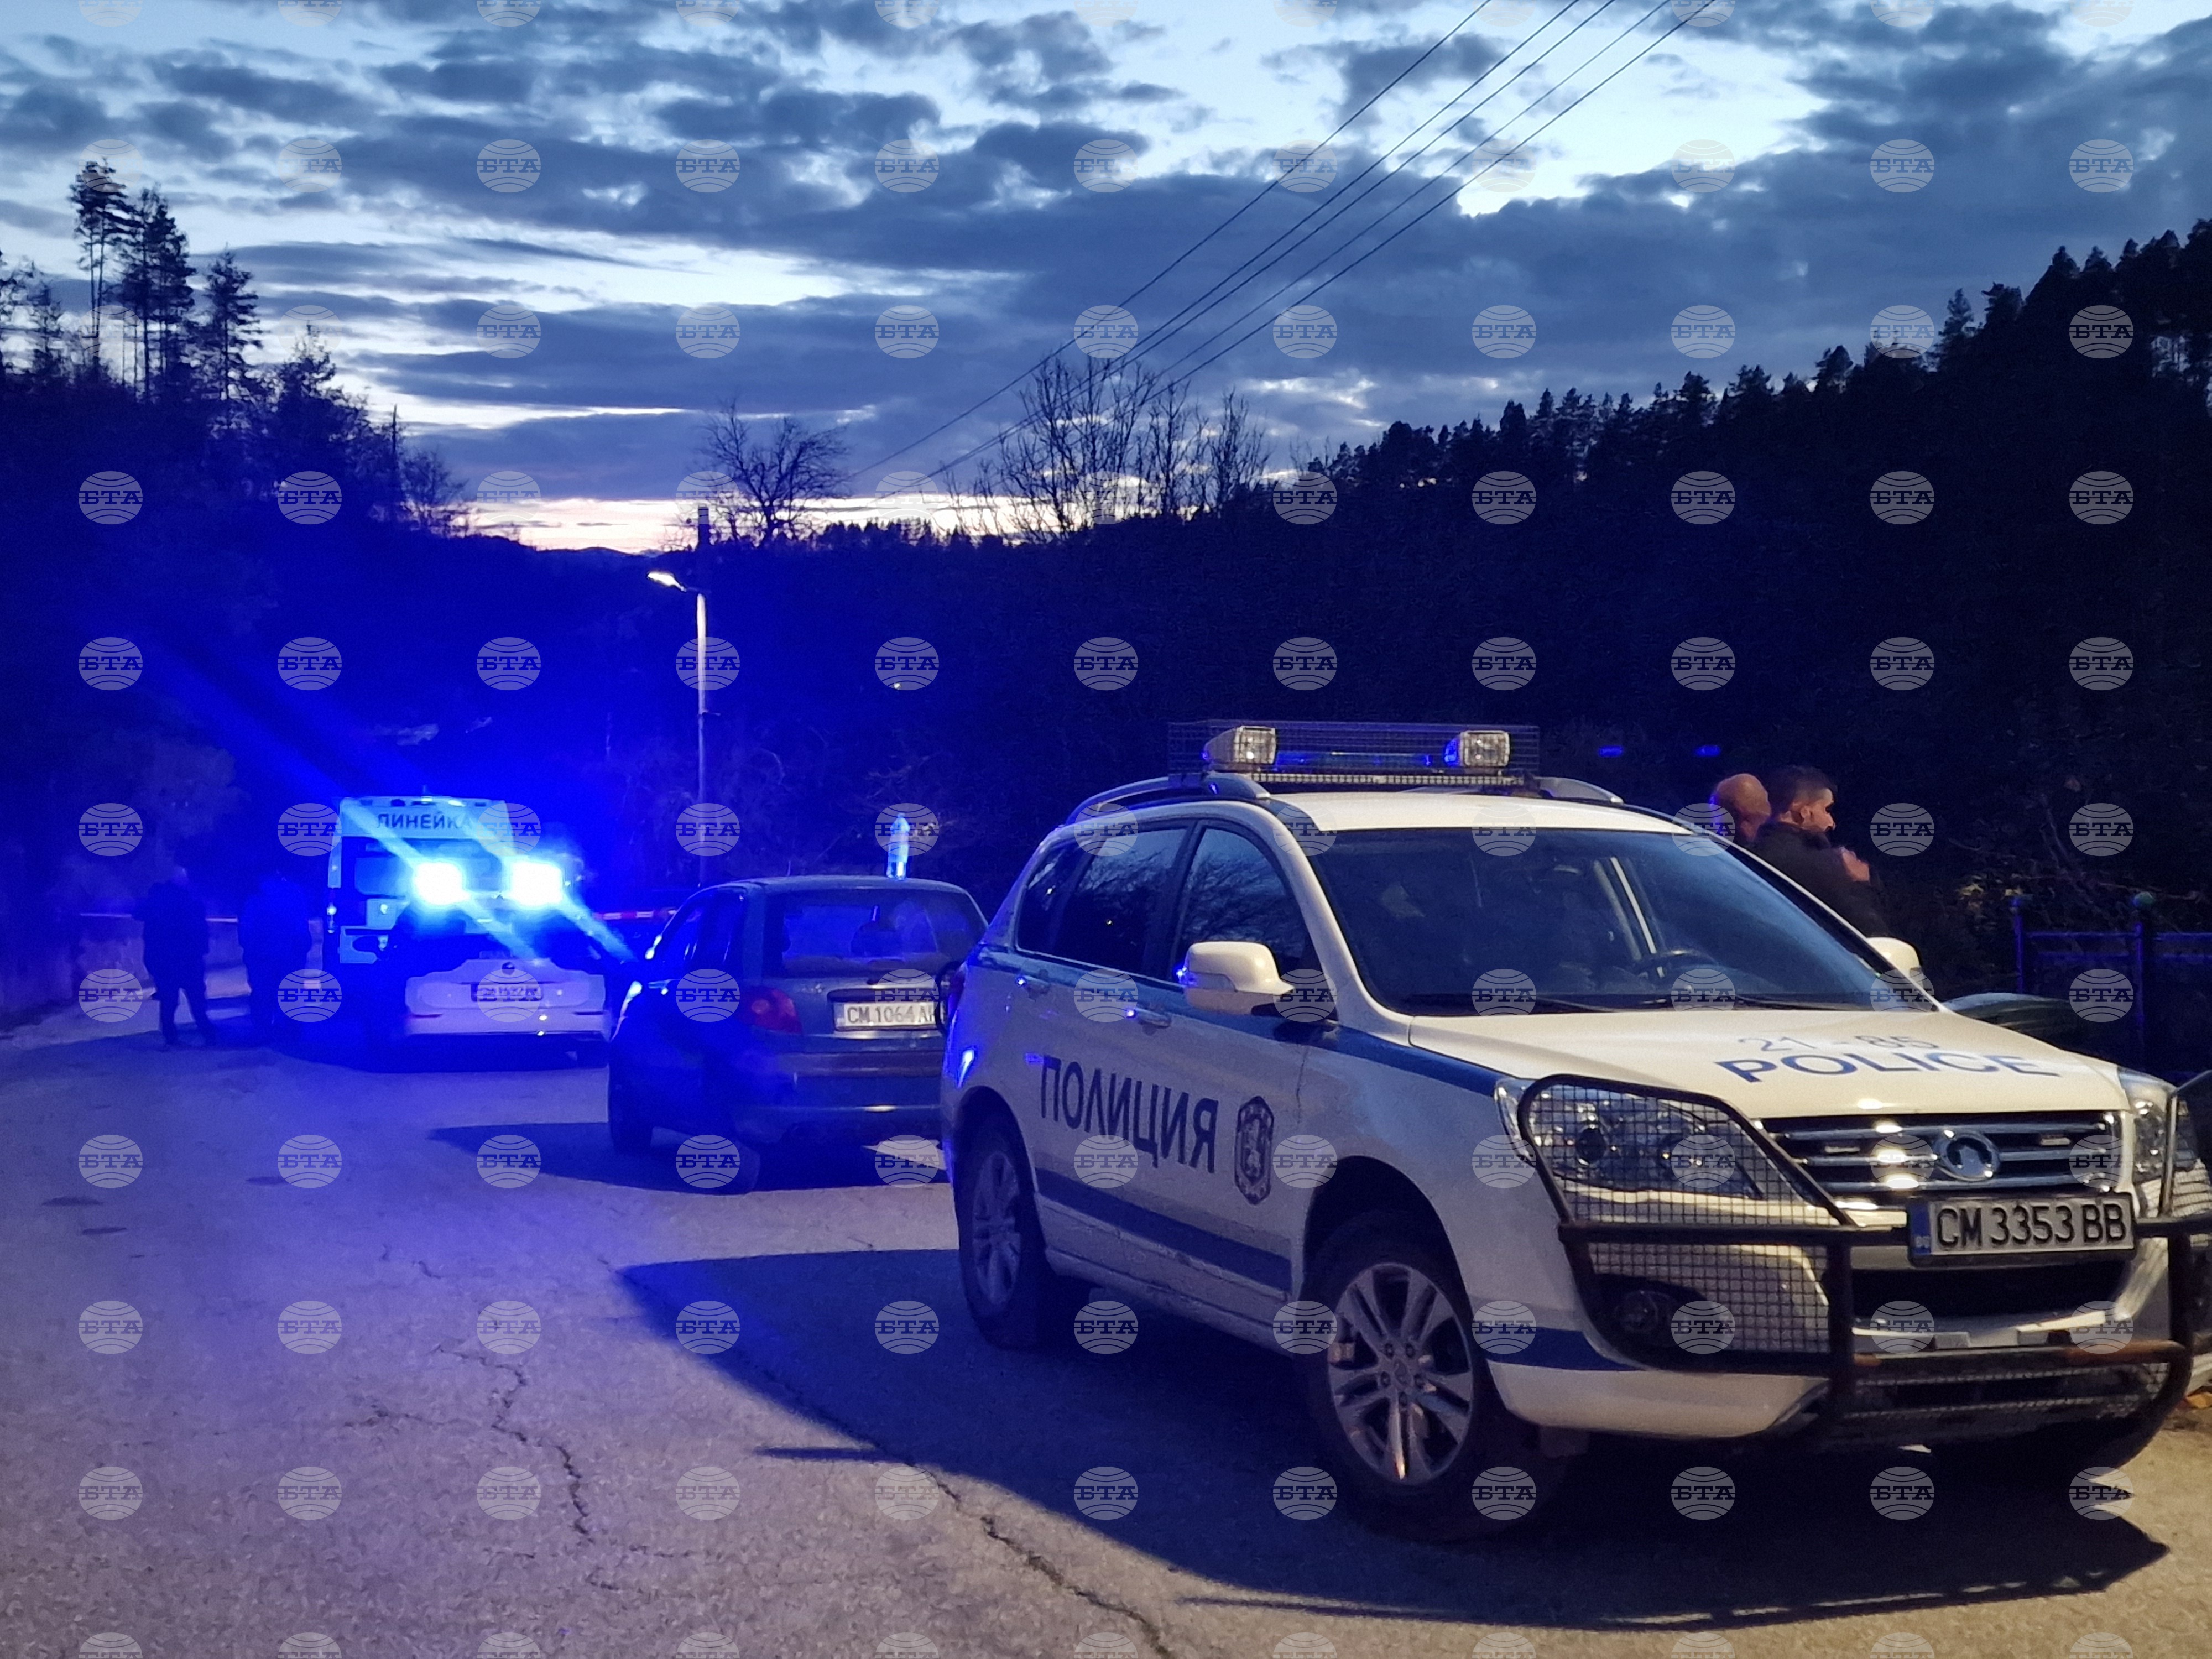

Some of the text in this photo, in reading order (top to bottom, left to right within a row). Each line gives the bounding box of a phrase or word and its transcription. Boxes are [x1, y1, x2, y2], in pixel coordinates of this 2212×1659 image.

[847, 1006, 870, 1023] CM
[875, 1006, 915, 1023] 1064
[1714, 1052, 2061, 1083] POLICE
[1040, 1054, 1219, 1174] ПОЛИЦИЯ
[1937, 1207, 1983, 1247] CM
[1991, 1204, 2075, 1245] 3353
[2081, 1203, 2127, 1243] BB
